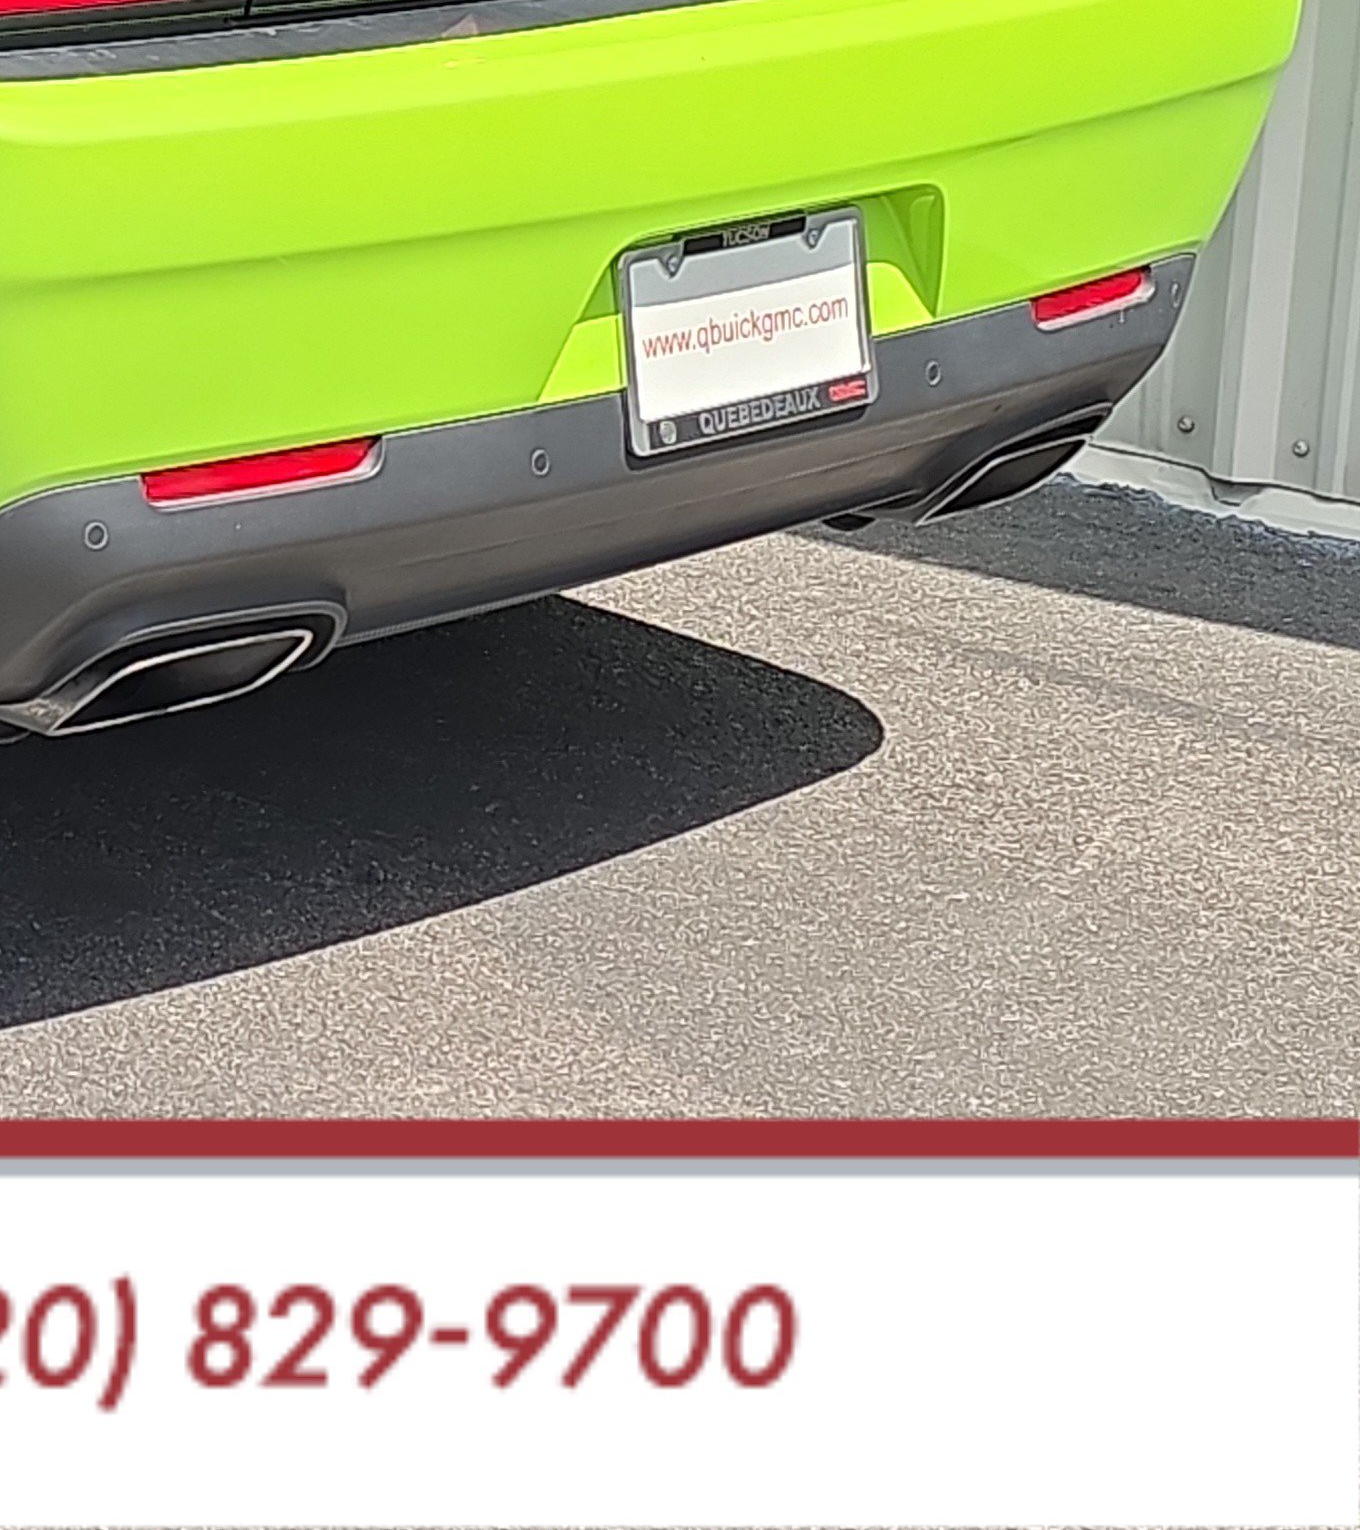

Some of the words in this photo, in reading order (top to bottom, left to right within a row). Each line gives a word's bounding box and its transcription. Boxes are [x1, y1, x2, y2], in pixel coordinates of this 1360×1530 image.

[722, 223, 771, 248] TUCSON
[642, 296, 848, 355] www.qbuickgmc.com
[698, 386, 821, 435] QUEBEDEAUX
